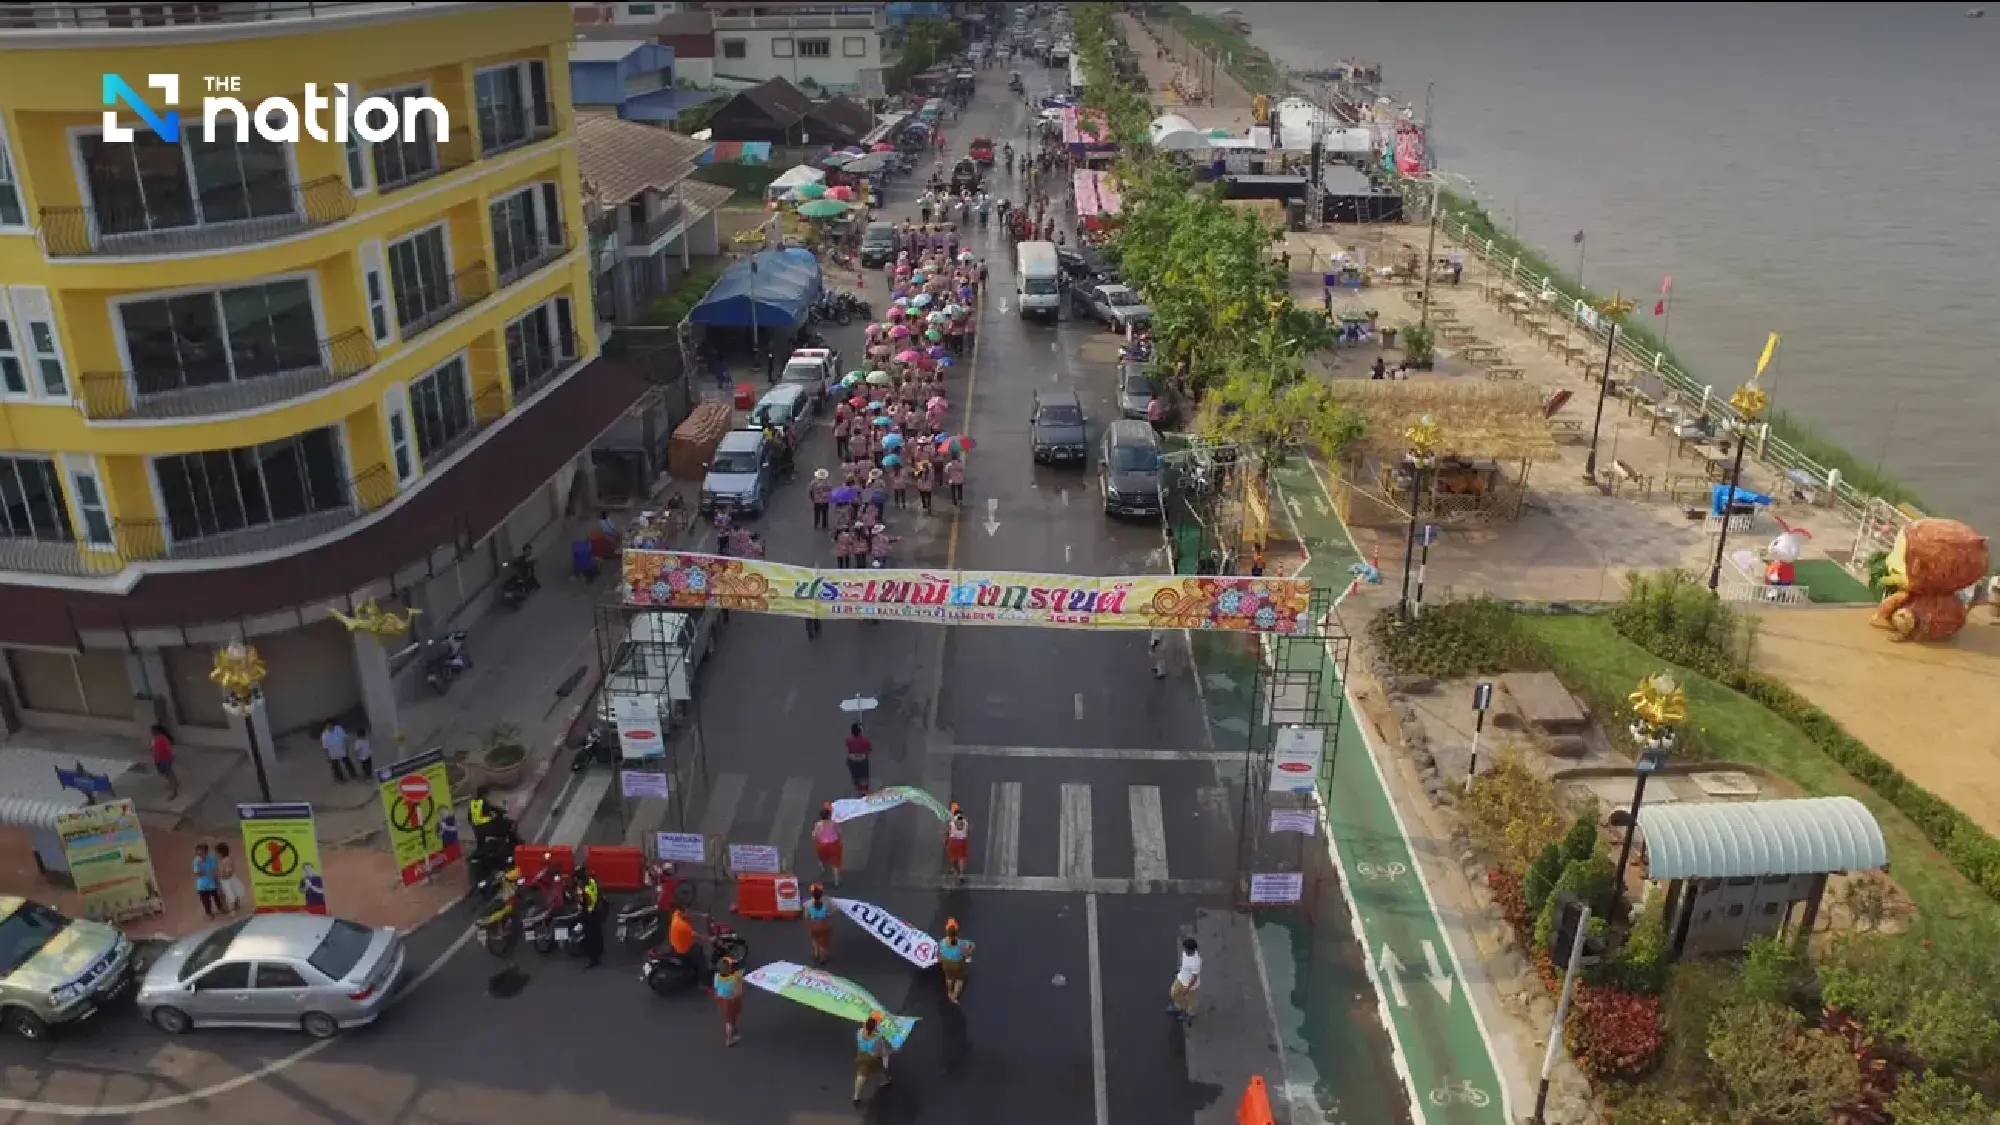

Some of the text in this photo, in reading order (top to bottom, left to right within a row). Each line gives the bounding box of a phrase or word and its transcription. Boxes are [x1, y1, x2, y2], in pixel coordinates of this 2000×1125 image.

[795, 573, 1132, 614] ประเพณีสงกรานต์
